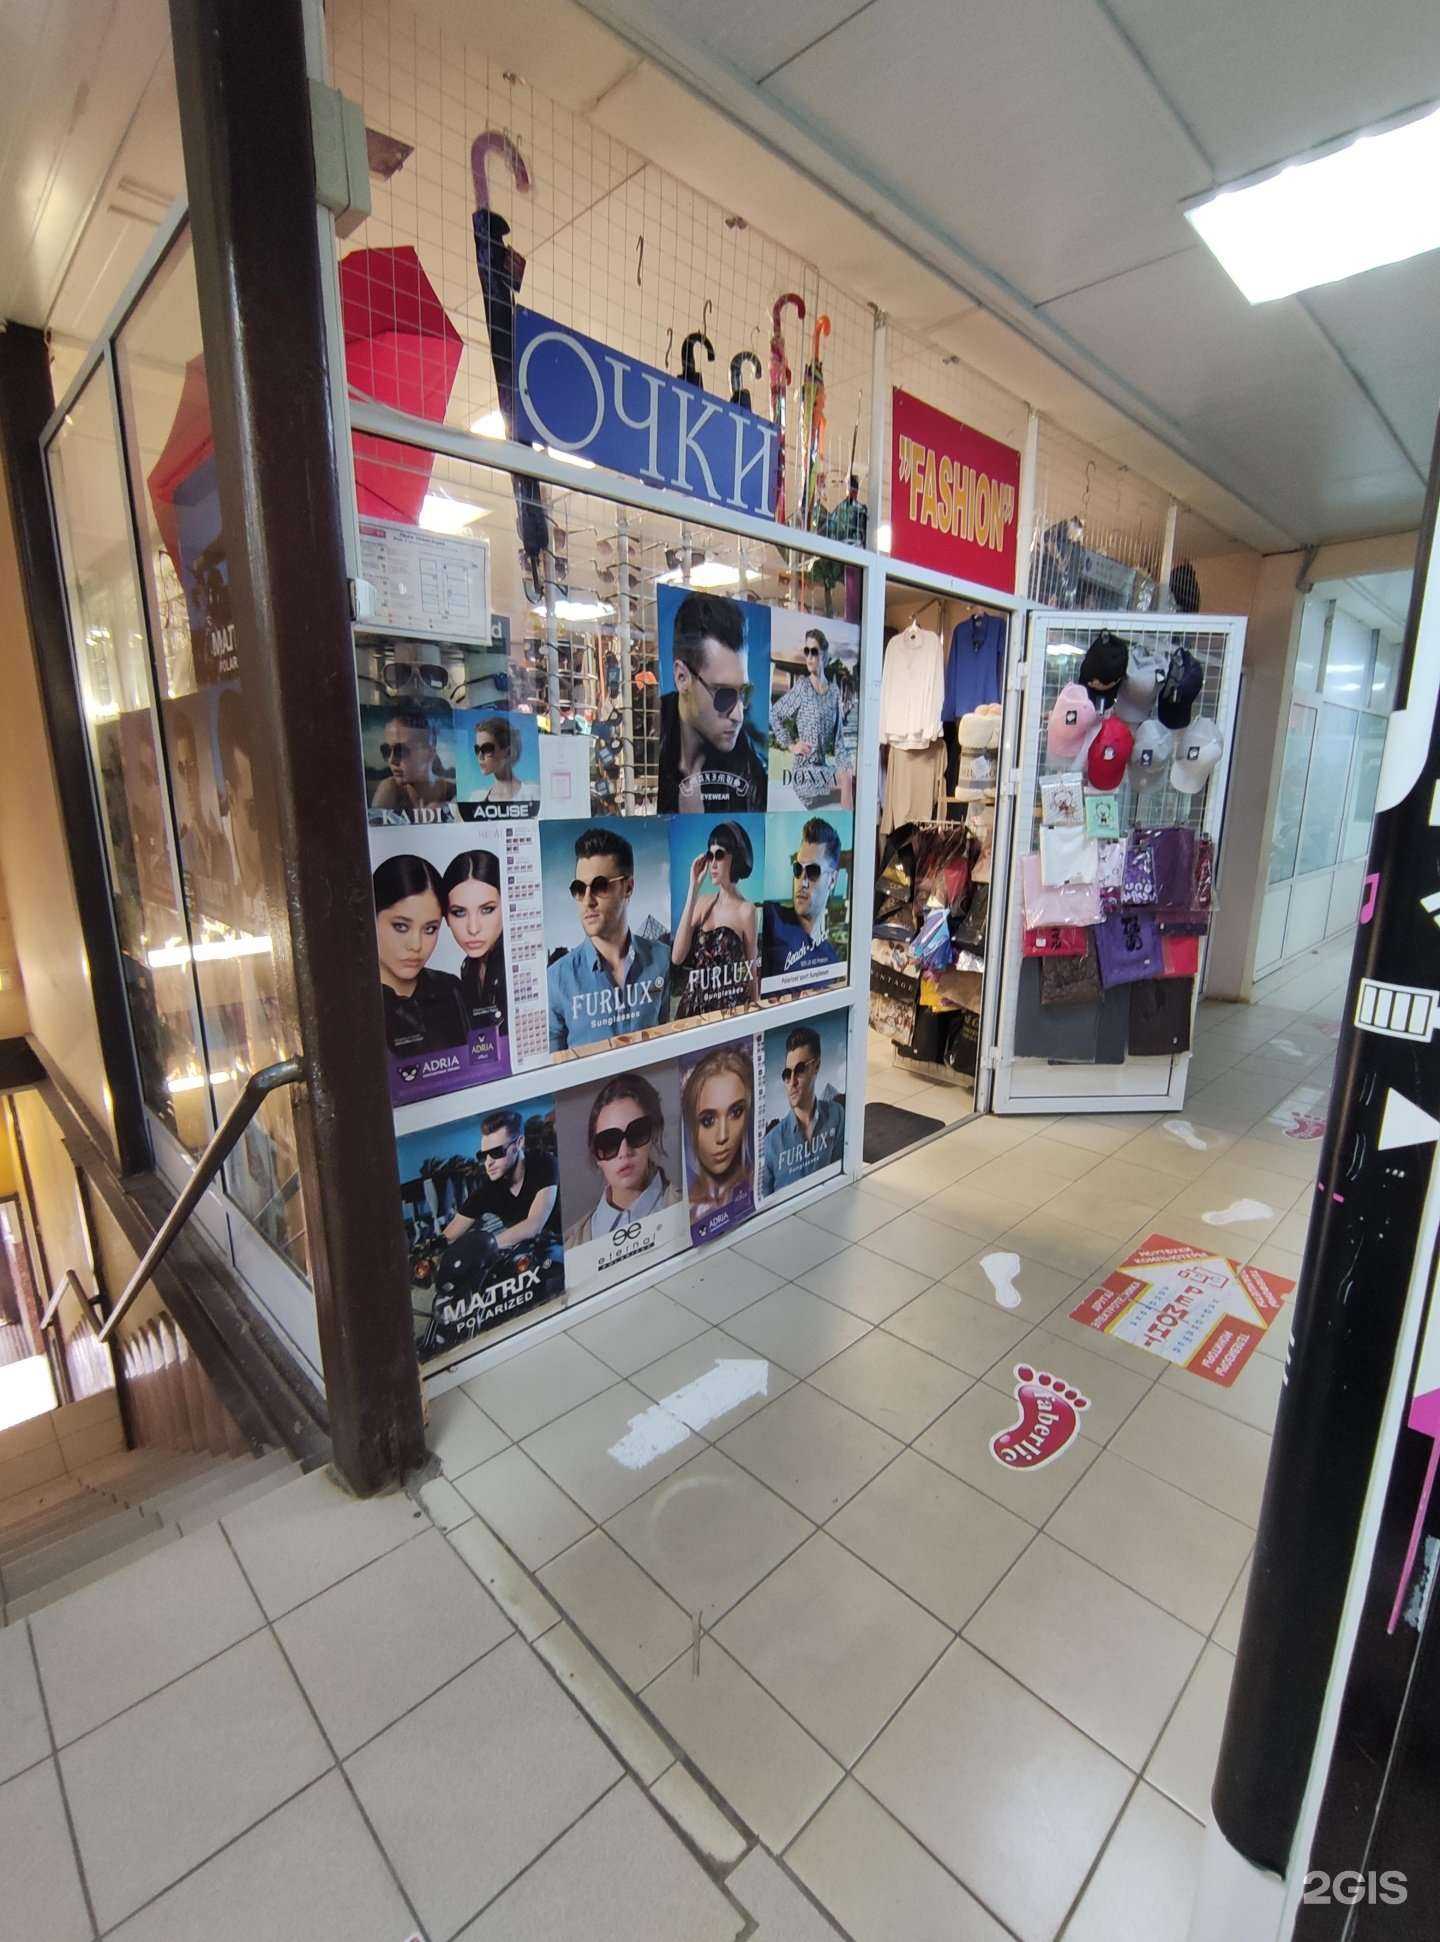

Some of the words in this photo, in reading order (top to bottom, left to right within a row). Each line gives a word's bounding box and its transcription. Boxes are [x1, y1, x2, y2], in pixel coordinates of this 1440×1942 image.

[518, 331, 779, 517] ОЧКИ
[688, 959, 754, 992] FURLUX
[590, 1011, 640, 1029] Sunglasses
[422, 1055, 460, 1074] ADRIA
[778, 1131, 828, 1170] FURLUX
[709, 1212, 729, 1229] ADRIA
[598, 1233, 656, 1265] eternal
[457, 1291, 534, 1334] POLARIZED
